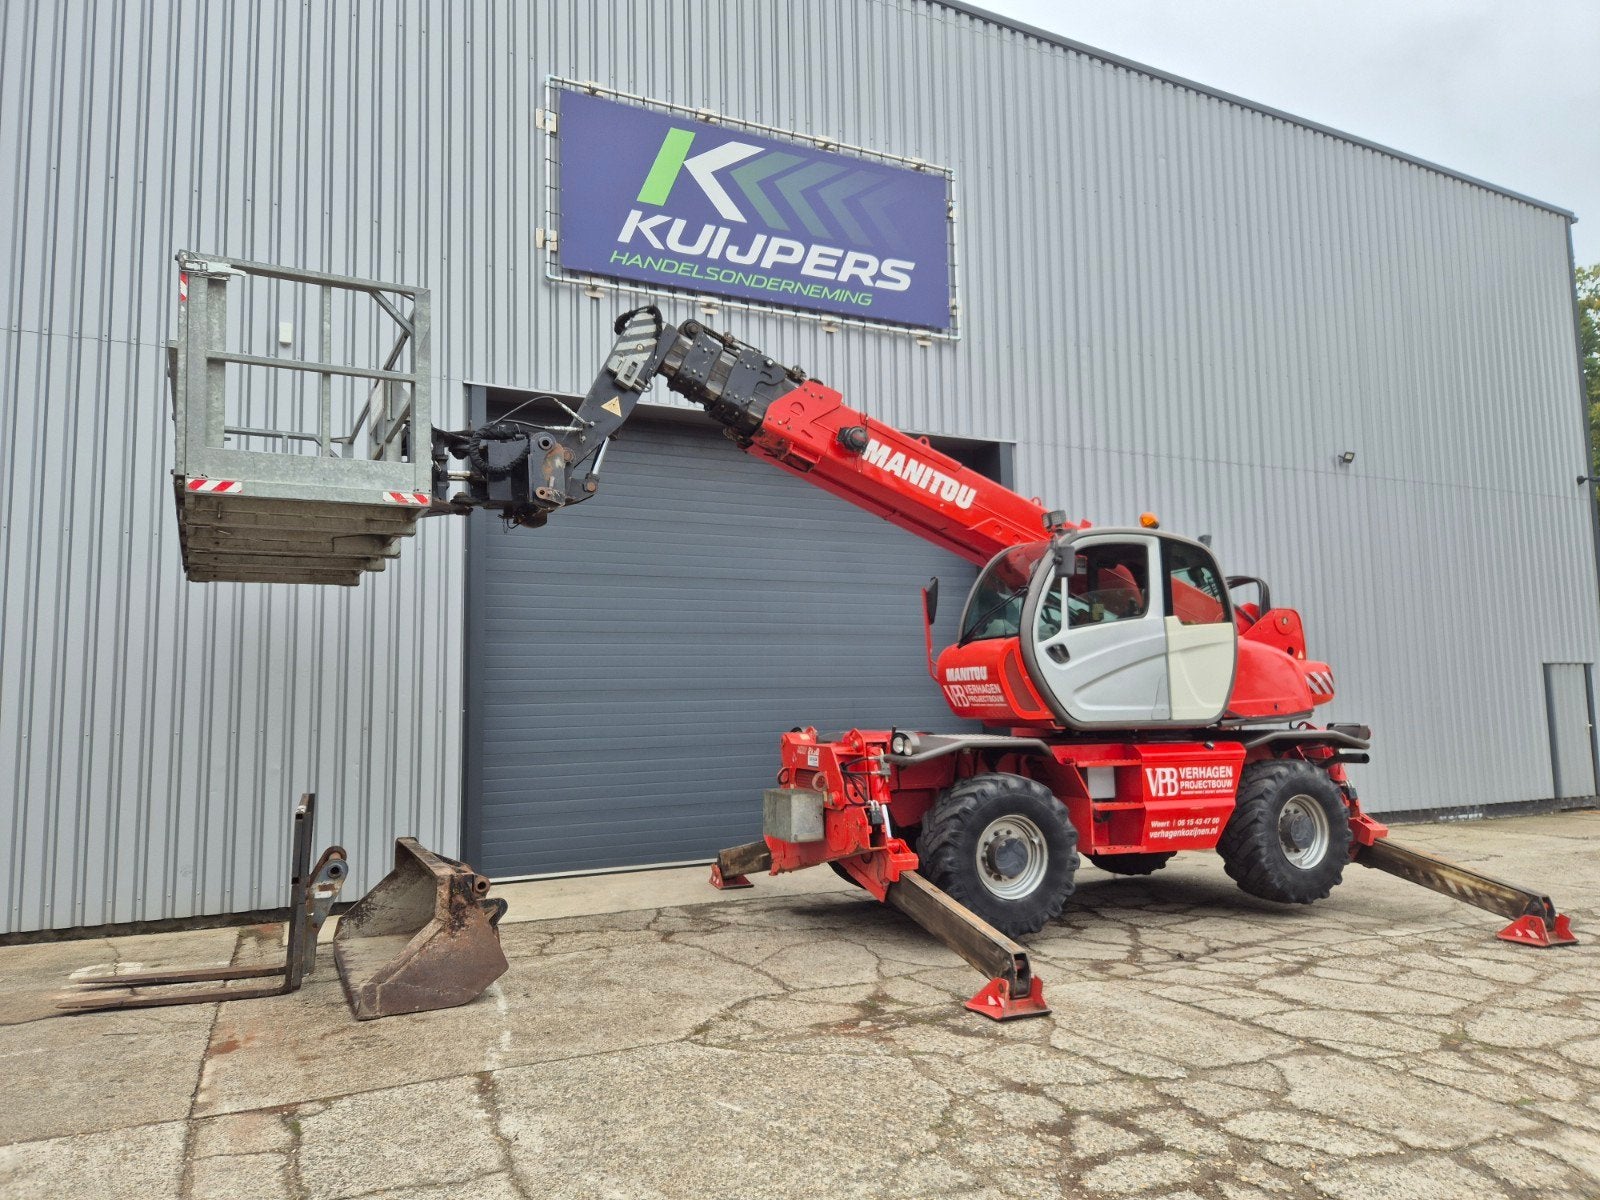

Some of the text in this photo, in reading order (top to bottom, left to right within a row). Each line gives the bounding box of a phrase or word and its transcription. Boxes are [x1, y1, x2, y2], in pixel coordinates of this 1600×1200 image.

[617, 209, 916, 292] KUIJPERS
[609, 250, 873, 307] HANDELSONDERNEMING
[862, 438, 977, 510] MANITOU
[946, 666, 988, 681] MANITOU
[943, 684, 970, 707] VPB
[962, 684, 1001, 694] VERHAGEN
[1145, 767, 1179, 797] VPB
[1179, 765, 1233, 779] VERHAGEN
[1180, 779, 1233, 789] PROJECTBOUW
